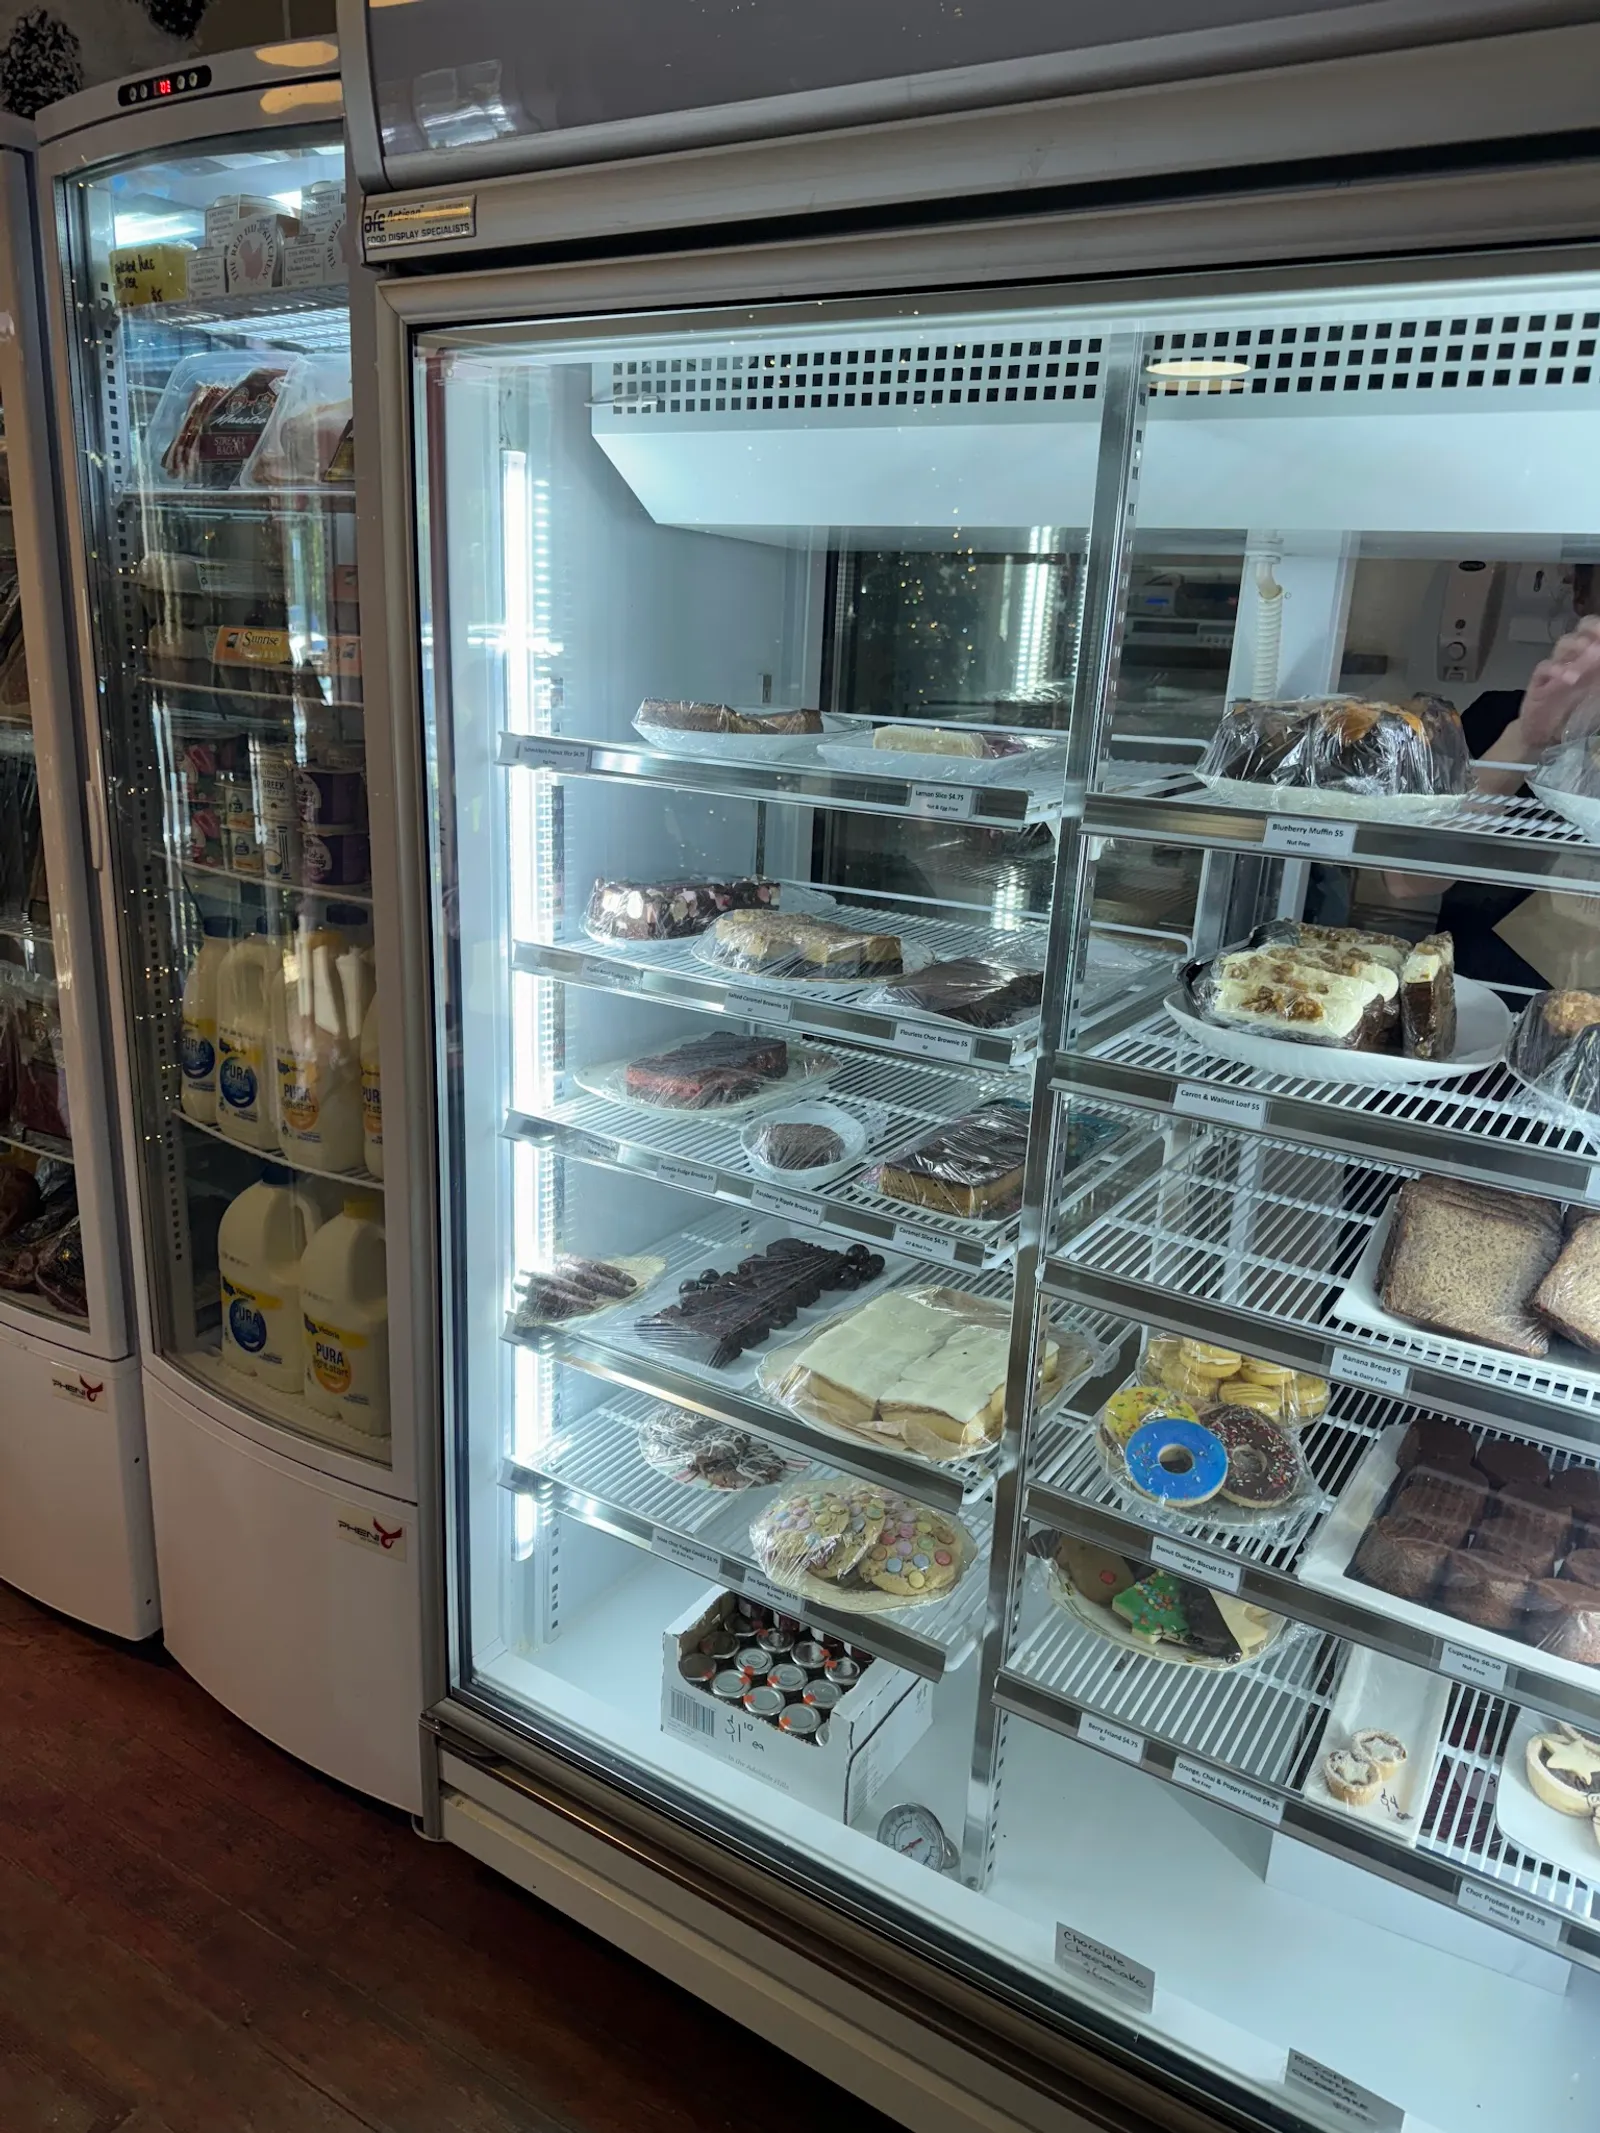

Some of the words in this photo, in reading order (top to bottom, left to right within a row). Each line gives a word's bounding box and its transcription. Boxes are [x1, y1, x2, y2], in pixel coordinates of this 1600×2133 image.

[366, 234, 386, 243] FOOD
[388, 230, 420, 241] DISPLAY
[421, 222, 470, 237] SPECIALISTS
[242, 632, 279, 647] Sunrise
[916, 790, 934, 798] Lemon
[1272, 823, 1307, 834] Blueberry
[1308, 826, 1333, 836] Muffin
[1334, 830, 1344, 838] $5
[728, 992, 742, 1000] Salted
[742, 996, 762, 1004] Caramel
[762, 1000, 782, 1008] Brownie
[900, 1029, 922, 1038] Flourless
[924, 1034, 936, 1042] Choc
[938, 1036, 960, 1046] Brownie
[961, 1040, 968, 1048] $5
[224, 1062, 250, 1080] PURA
[362, 1087, 381, 1102] PUR
[1180, 1089, 1202, 1100] Carrot
[1210, 1095, 1235, 1106] Walnut
[1236, 1100, 1250, 1108] Loaf
[756, 1189, 779, 1202] Raspberry
[779, 1198, 794, 1207] Ripple
[794, 1203, 812, 1213] Brookie
[899, 1226, 921, 1238] Caramel
[921, 1233, 933, 1242] Slice
[234, 1305, 259, 1324] PURA
[316, 1342, 344, 1366] PURA
[1342, 1354, 1368, 1367] Banana
[1370, 1362, 1391, 1374] Bread
[1392, 1368, 1402, 1376] $5
[1342, 1367, 1352, 1376] Nut
[1360, 1372, 1374, 1382] Dairy
[1375, 1377, 1388, 1386] Free
[1156, 1544, 1174, 1556] Donut
[1175, 1551, 1196, 1564] Dunker
[1197, 1560, 1218, 1572] Biscuit
[1448, 1647, 1480, 1664] Cupcakes
[1482, 1659, 1502, 1670] $6.50
[1473, 1668, 1486, 1676] Free
[1088, 1722, 1104, 1734] Berry
[1104, 1729, 1122, 1740] Friand
[1178, 1762, 1202, 1778] Orange,
[1202, 1772, 1216, 1784] Chai
[1222, 1781, 1242, 1796] Poppy
[1242, 1790, 1262, 1803] Friand
[1200, 1781, 1212, 1790] Free
[1466, 1886, 1483, 1900] Choc
[1484, 1894, 1510, 1911] Protein
[1511, 1906, 1525, 1916] Ball
[1064, 1931, 1126, 1968] Chocolate
[1064, 1942, 1146, 1989] Cheesecake
